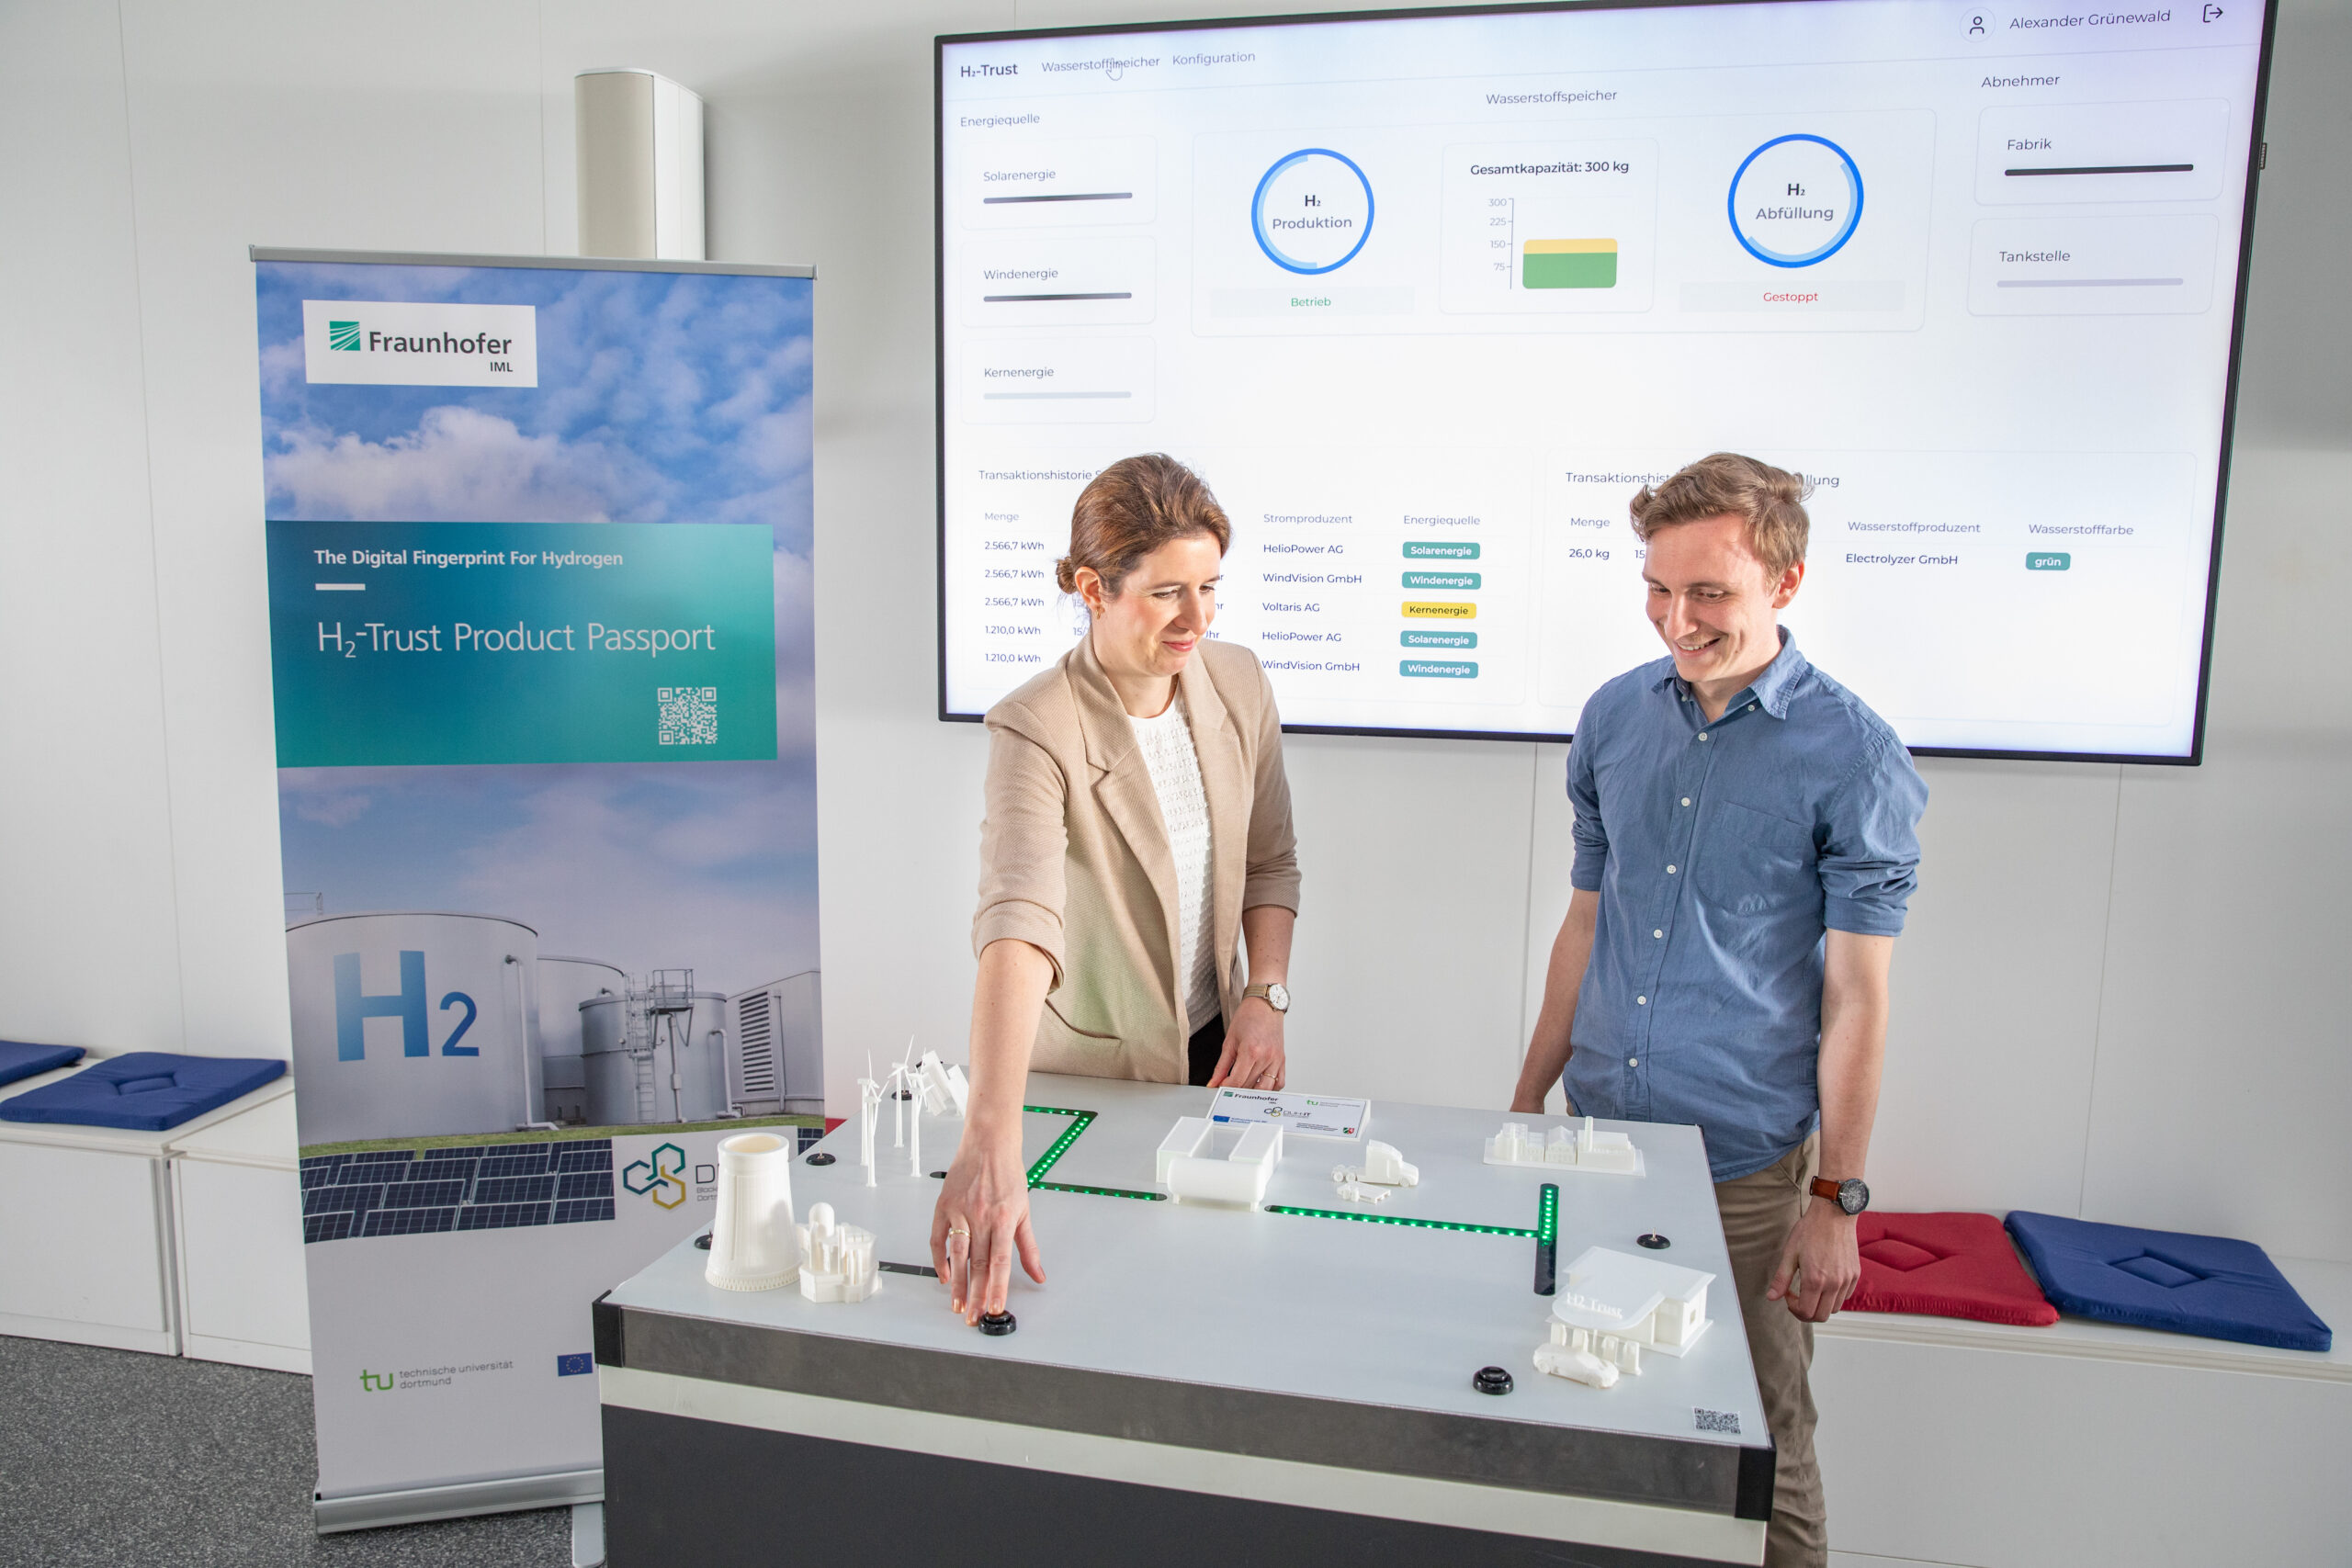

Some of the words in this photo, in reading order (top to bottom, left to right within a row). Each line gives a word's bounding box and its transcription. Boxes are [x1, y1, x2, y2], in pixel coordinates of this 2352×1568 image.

[2009, 16, 2085, 29] Alexander
[2087, 9, 2171, 26] Grünewald
[1172, 52, 1256, 67] Konfiguration
[1981, 75, 2059, 88] Abnehmer
[1486, 89, 1618, 105] Wasserstoffspeicher
[960, 113, 1040, 129] Energiequelle
[2007, 138, 2052, 151] Fabrik
[1470, 162, 1582, 175] Gesamtkapazität:
[1585, 161, 1610, 173] 300
[1612, 160, 1630, 175] kg
[983, 168, 1057, 182] Solarenergie
[1488, 197, 1508, 208] 300
[1756, 207, 1834, 221] Abfüllung
[1272, 216, 1352, 230] Produktion
[1489, 217, 1507, 227] 225
[1490, 240, 1507, 249] 150
[1998, 250, 2071, 263] Tankstelle
[1493, 262, 1506, 272] 75
[983, 268, 1058, 281] Windenergie
[1291, 297, 1331, 308] Betrieb
[1763, 292, 1818, 304] Gestoppt
[369, 331, 513, 355] Fraunhofer
[490, 361, 514, 373] IML
[984, 367, 1055, 379] Kernenergie
[978, 469, 1092, 481] Transaktionshistorie
[1565, 471, 1669, 484] Transaktionshist
[984, 512, 1020, 524] Menge
[1263, 513, 1353, 524] Stromproduzent
[1403, 514, 1481, 527] Energiequelle
[1570, 517, 1611, 529] Menge
[1848, 521, 1981, 533] Wasserstoffproduzent
[2029, 524, 2134, 536] Wasserstofffarbe
[984, 541, 1019, 550] 2.566,7
[1021, 540, 1045, 551] kWh
[1263, 544, 1325, 555] HelioPower
[1327, 545, 1343, 554] AG
[1410, 545, 1473, 558] Solarenergie
[313, 548, 347, 565] The
[352, 549, 408, 569] Digital
[413, 549, 505, 569] Fingerprint
[510, 550, 537, 566] For
[541, 549, 625, 569] Hydrogen
[1568, 548, 1593, 558] 26,0
[1594, 547, 1611, 561] kg
[1846, 553, 1915, 566] Electrolyzer
[1918, 554, 1958, 565] GmbH
[2033, 556, 2063, 569] grün
[984, 569, 1019, 579] 2.566,7
[1021, 569, 1045, 579] kWh
[1262, 572, 1324, 583] WindVision
[1327, 574, 1363, 584] GmbH
[1409, 575, 1475, 588] Windenergie
[985, 597, 1019, 607] 2.566,7
[1021, 597, 1045, 607] kWh
[1261, 602, 1302, 613] Voltaris
[1304, 603, 1320, 613] AG
[1408, 604, 1470, 617] Kernenergie
[985, 625, 1015, 637] 1.210,0
[1017, 626, 1041, 636] kWh
[1261, 631, 1323, 642] HelioPower
[1326, 633, 1341, 642] AG
[454, 622, 577, 653] Product
[588, 622, 716, 659] Passport
[1408, 634, 1470, 647] Solarenergie
[985, 653, 1015, 664] 1.210,0
[1017, 654, 1041, 663] kWh
[1261, 660, 1322, 671] WindVision
[1325, 661, 1360, 671] GmbH
[1408, 663, 1471, 676] Windenergie
[1234, 1093, 1279, 1102] Fraunhofer
[1589, 1298, 1623, 1319] Trust
[399, 1366, 457, 1379] technische
[458, 1360, 514, 1374] universität
[360, 1369, 393, 1392] tu
[399, 1377, 452, 1390] dortmund
